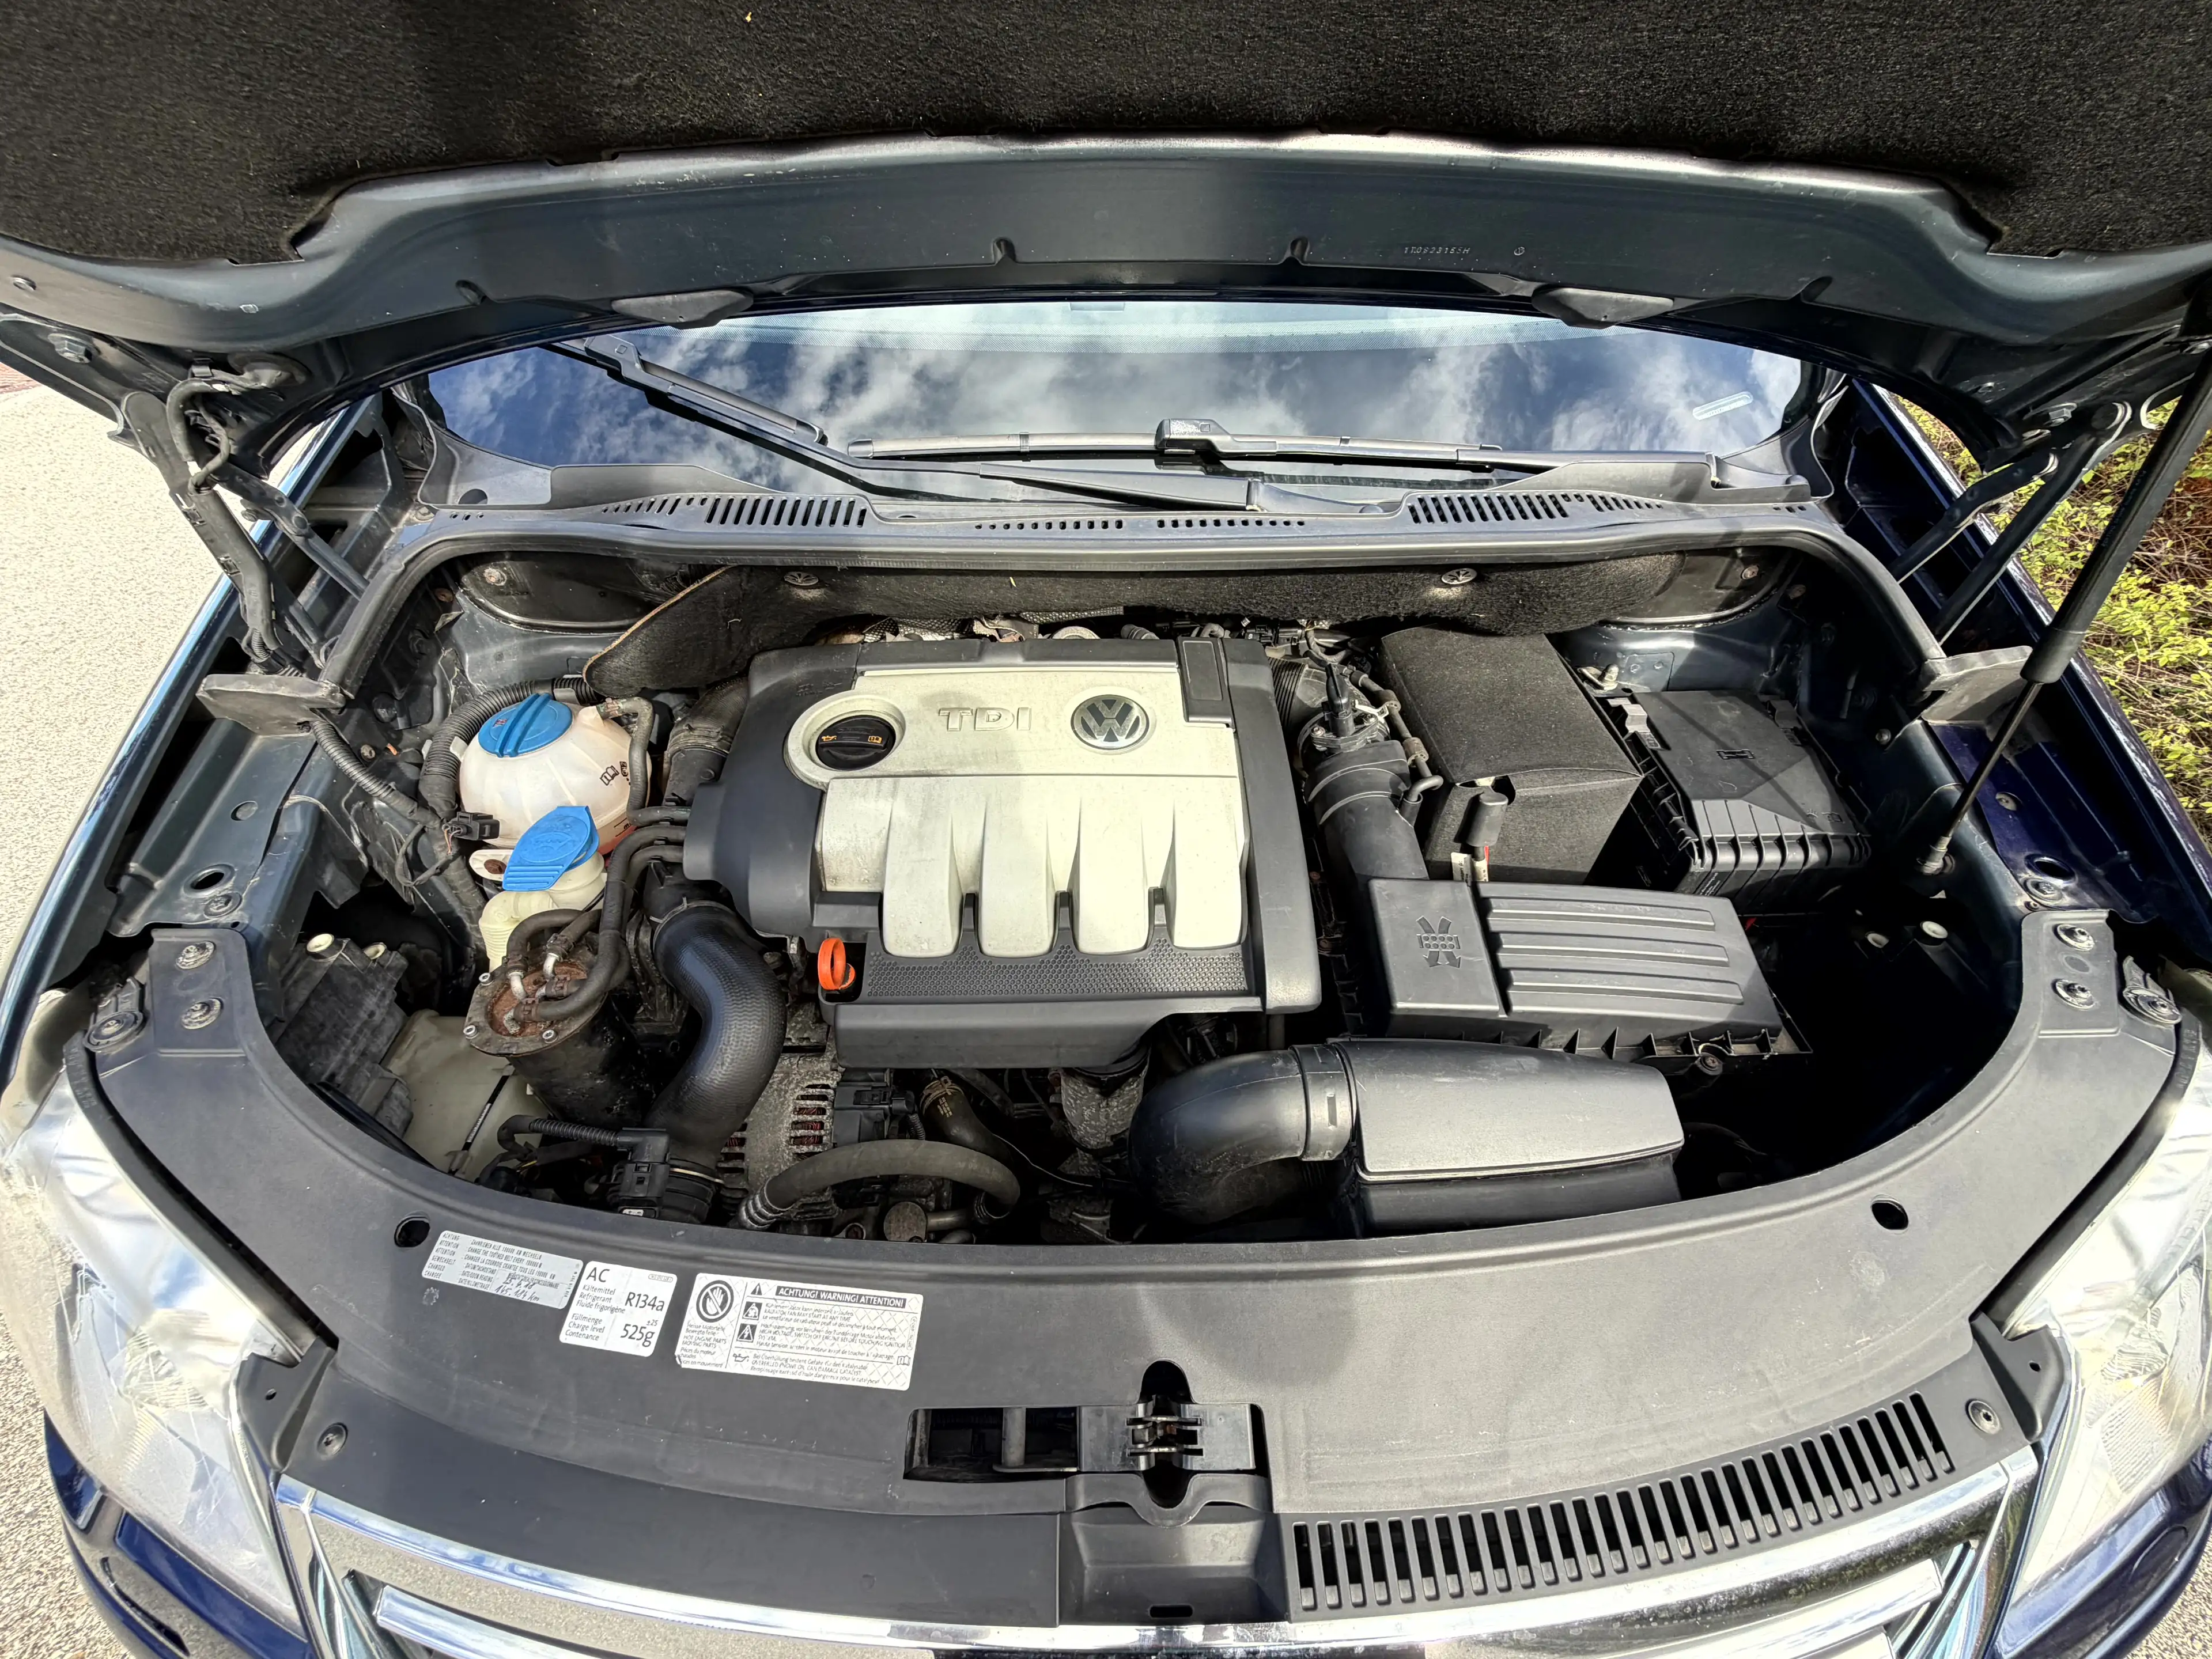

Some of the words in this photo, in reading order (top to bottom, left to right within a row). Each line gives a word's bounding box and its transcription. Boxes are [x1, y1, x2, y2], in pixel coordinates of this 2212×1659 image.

[938, 707, 1032, 732] TDI
[443, 1232, 460, 1241] ACHTUNG
[436, 1247, 456, 1256] ATTENTION
[464, 1254, 481, 1262] CHANGER
[439, 1239, 459, 1248] ATTENTION
[467, 1246, 482, 1254] CHANGE
[489, 1251, 505, 1259] TOOTHED
[428, 1262, 445, 1271] CHANGED
[432, 1255, 456, 1265] GEWECHSELT
[585, 1267, 610, 1283] AC
[527, 1291, 540, 1301] km
[583, 1284, 615, 1295] Kältemittel
[579, 1292, 612, 1305] Refrigerant
[624, 1291, 666, 1312] R134a
[778, 1287, 818, 1299] ACHTUNG!
[820, 1291, 859, 1303] WARNING!
[859, 1296, 903, 1307] ATTENTION!
[576, 1300, 593, 1309] Fluide
[594, 1302, 626, 1316] frigorigène
[571, 1313, 603, 1325] Füllmenge
[568, 1321, 589, 1332] Charge
[591, 1325, 604, 1333] level
[565, 1330, 599, 1340] Contenance
[619, 1323, 655, 1347] 525g
